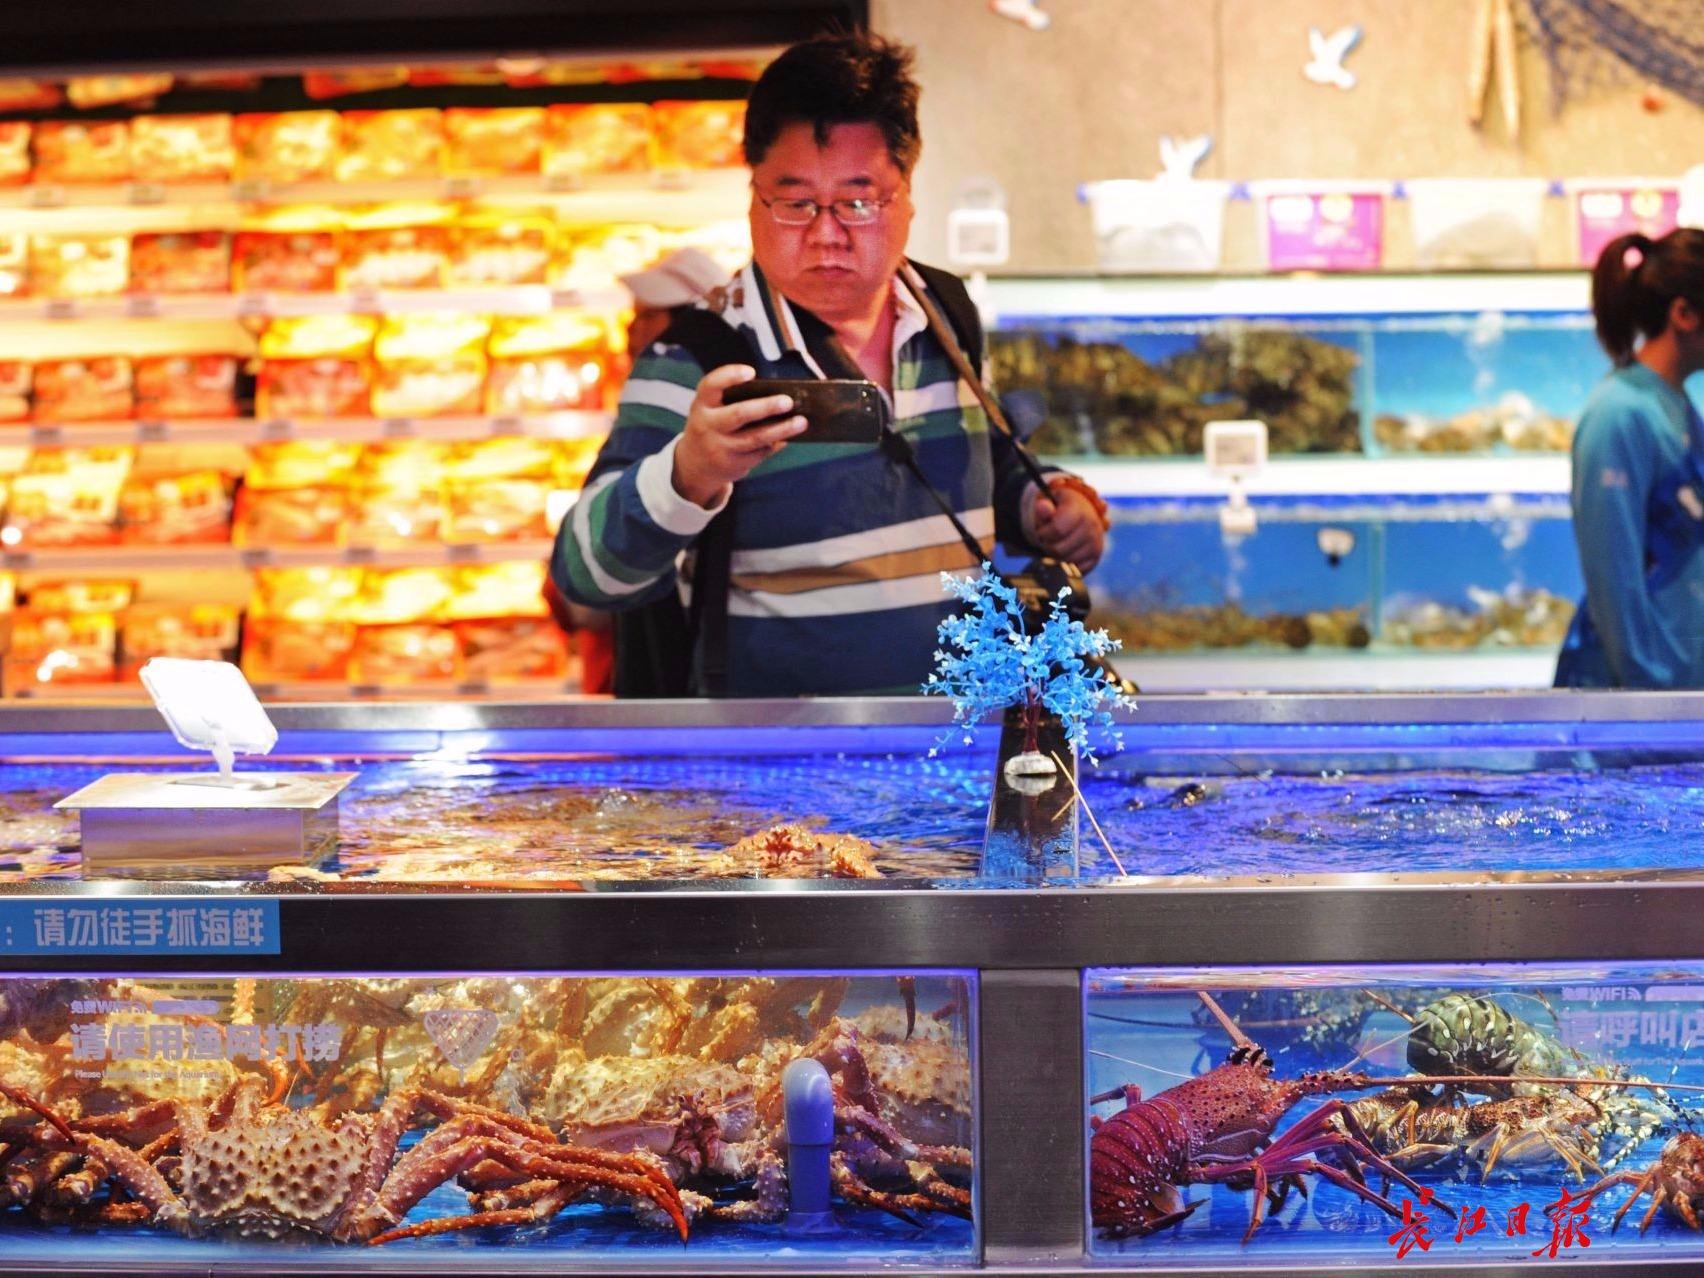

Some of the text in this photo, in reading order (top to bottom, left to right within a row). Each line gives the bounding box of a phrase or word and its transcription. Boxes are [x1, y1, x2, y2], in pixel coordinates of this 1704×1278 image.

[70, 1022, 342, 1062] 请使用渔网打捞
